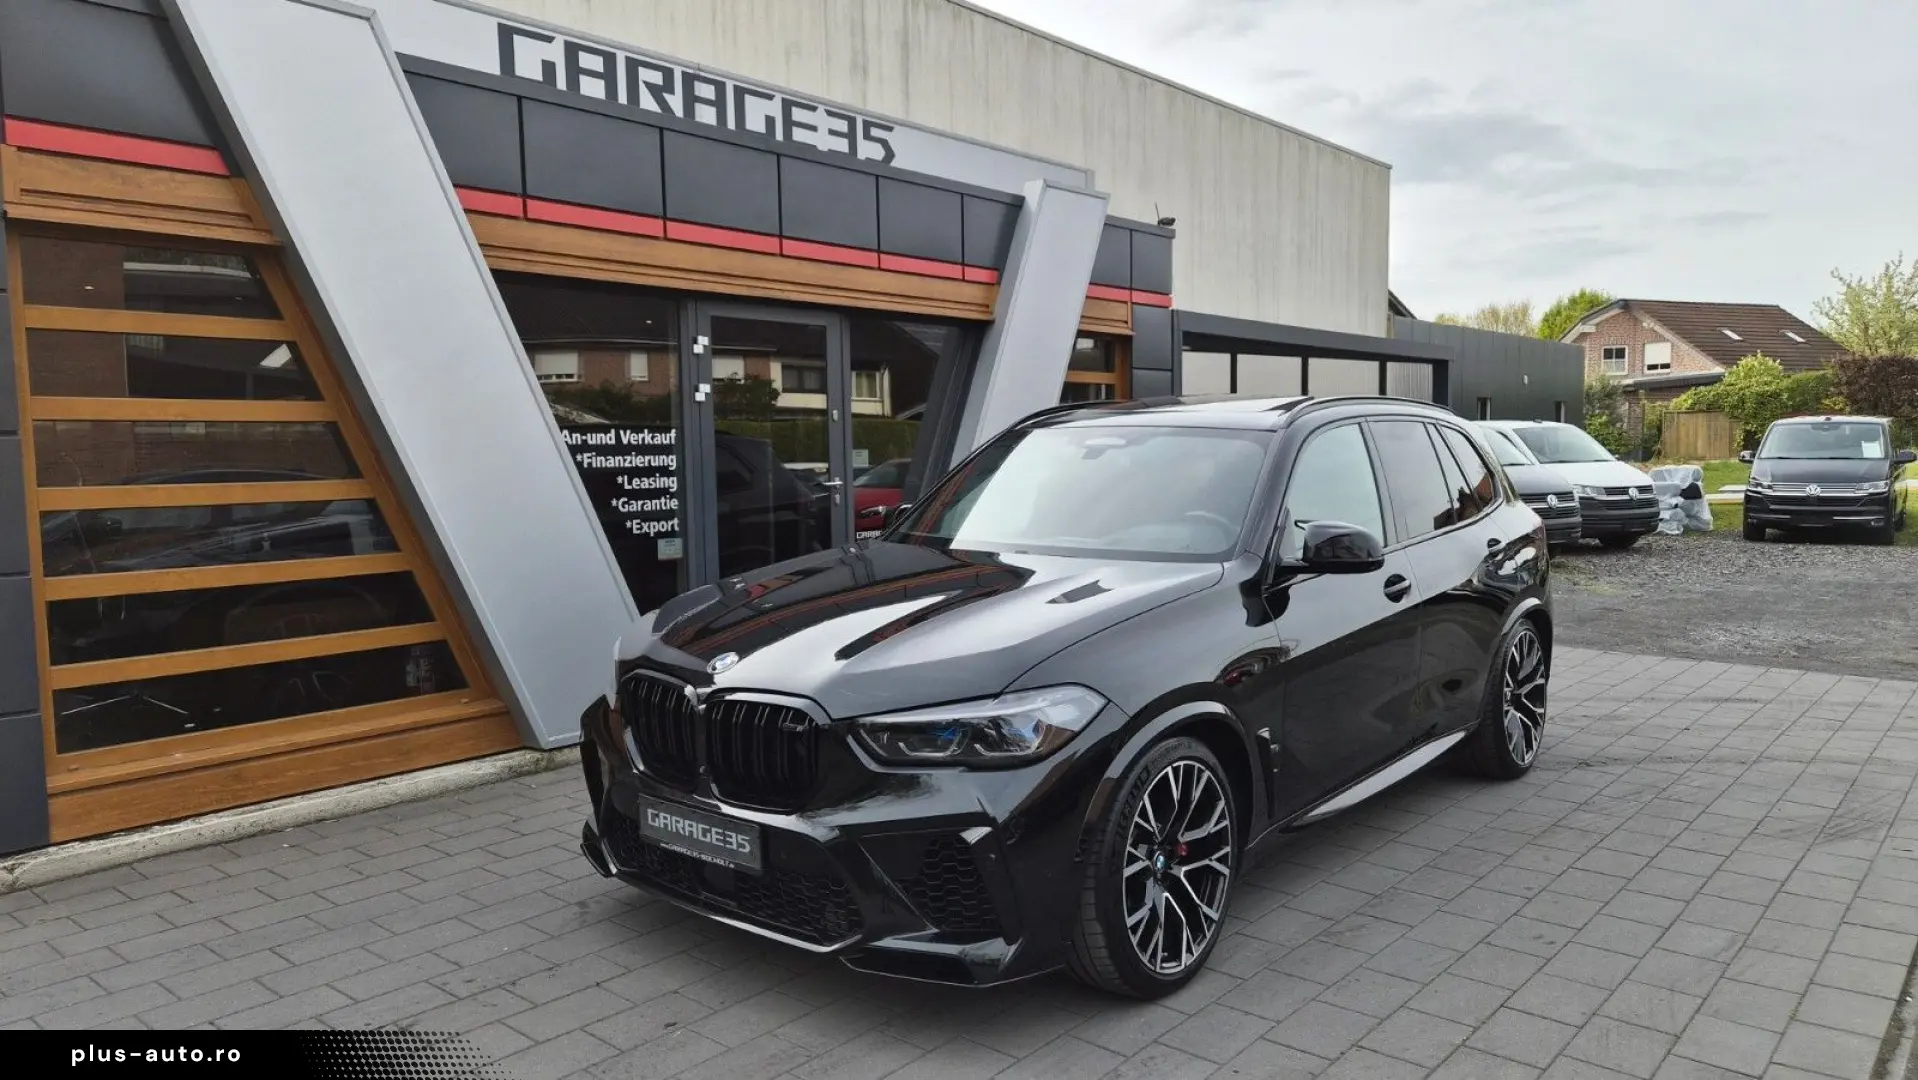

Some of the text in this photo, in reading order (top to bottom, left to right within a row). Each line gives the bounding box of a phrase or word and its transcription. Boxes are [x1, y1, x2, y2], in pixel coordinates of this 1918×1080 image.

[497, 22, 896, 166] GARAGE35
[620, 428, 677, 446] Verkauf
[647, 809, 751, 853] GARAGE35
